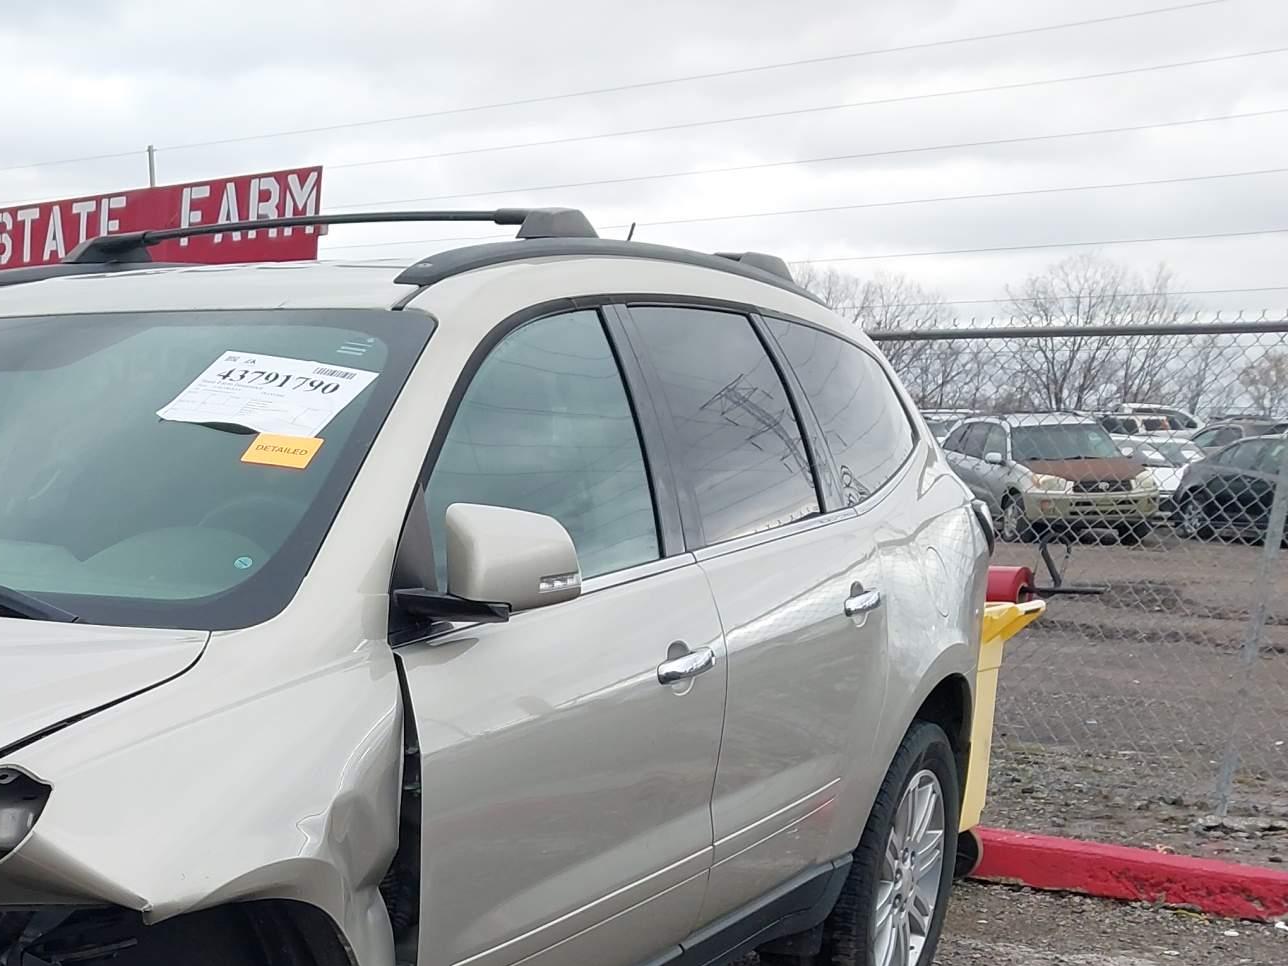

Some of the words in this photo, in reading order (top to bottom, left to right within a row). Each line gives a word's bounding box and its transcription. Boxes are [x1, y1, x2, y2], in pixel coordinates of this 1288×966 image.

[179, 171, 319, 247] FARM
[217, 367, 340, 395] 43791790
[255, 444, 309, 456] DETAILED
